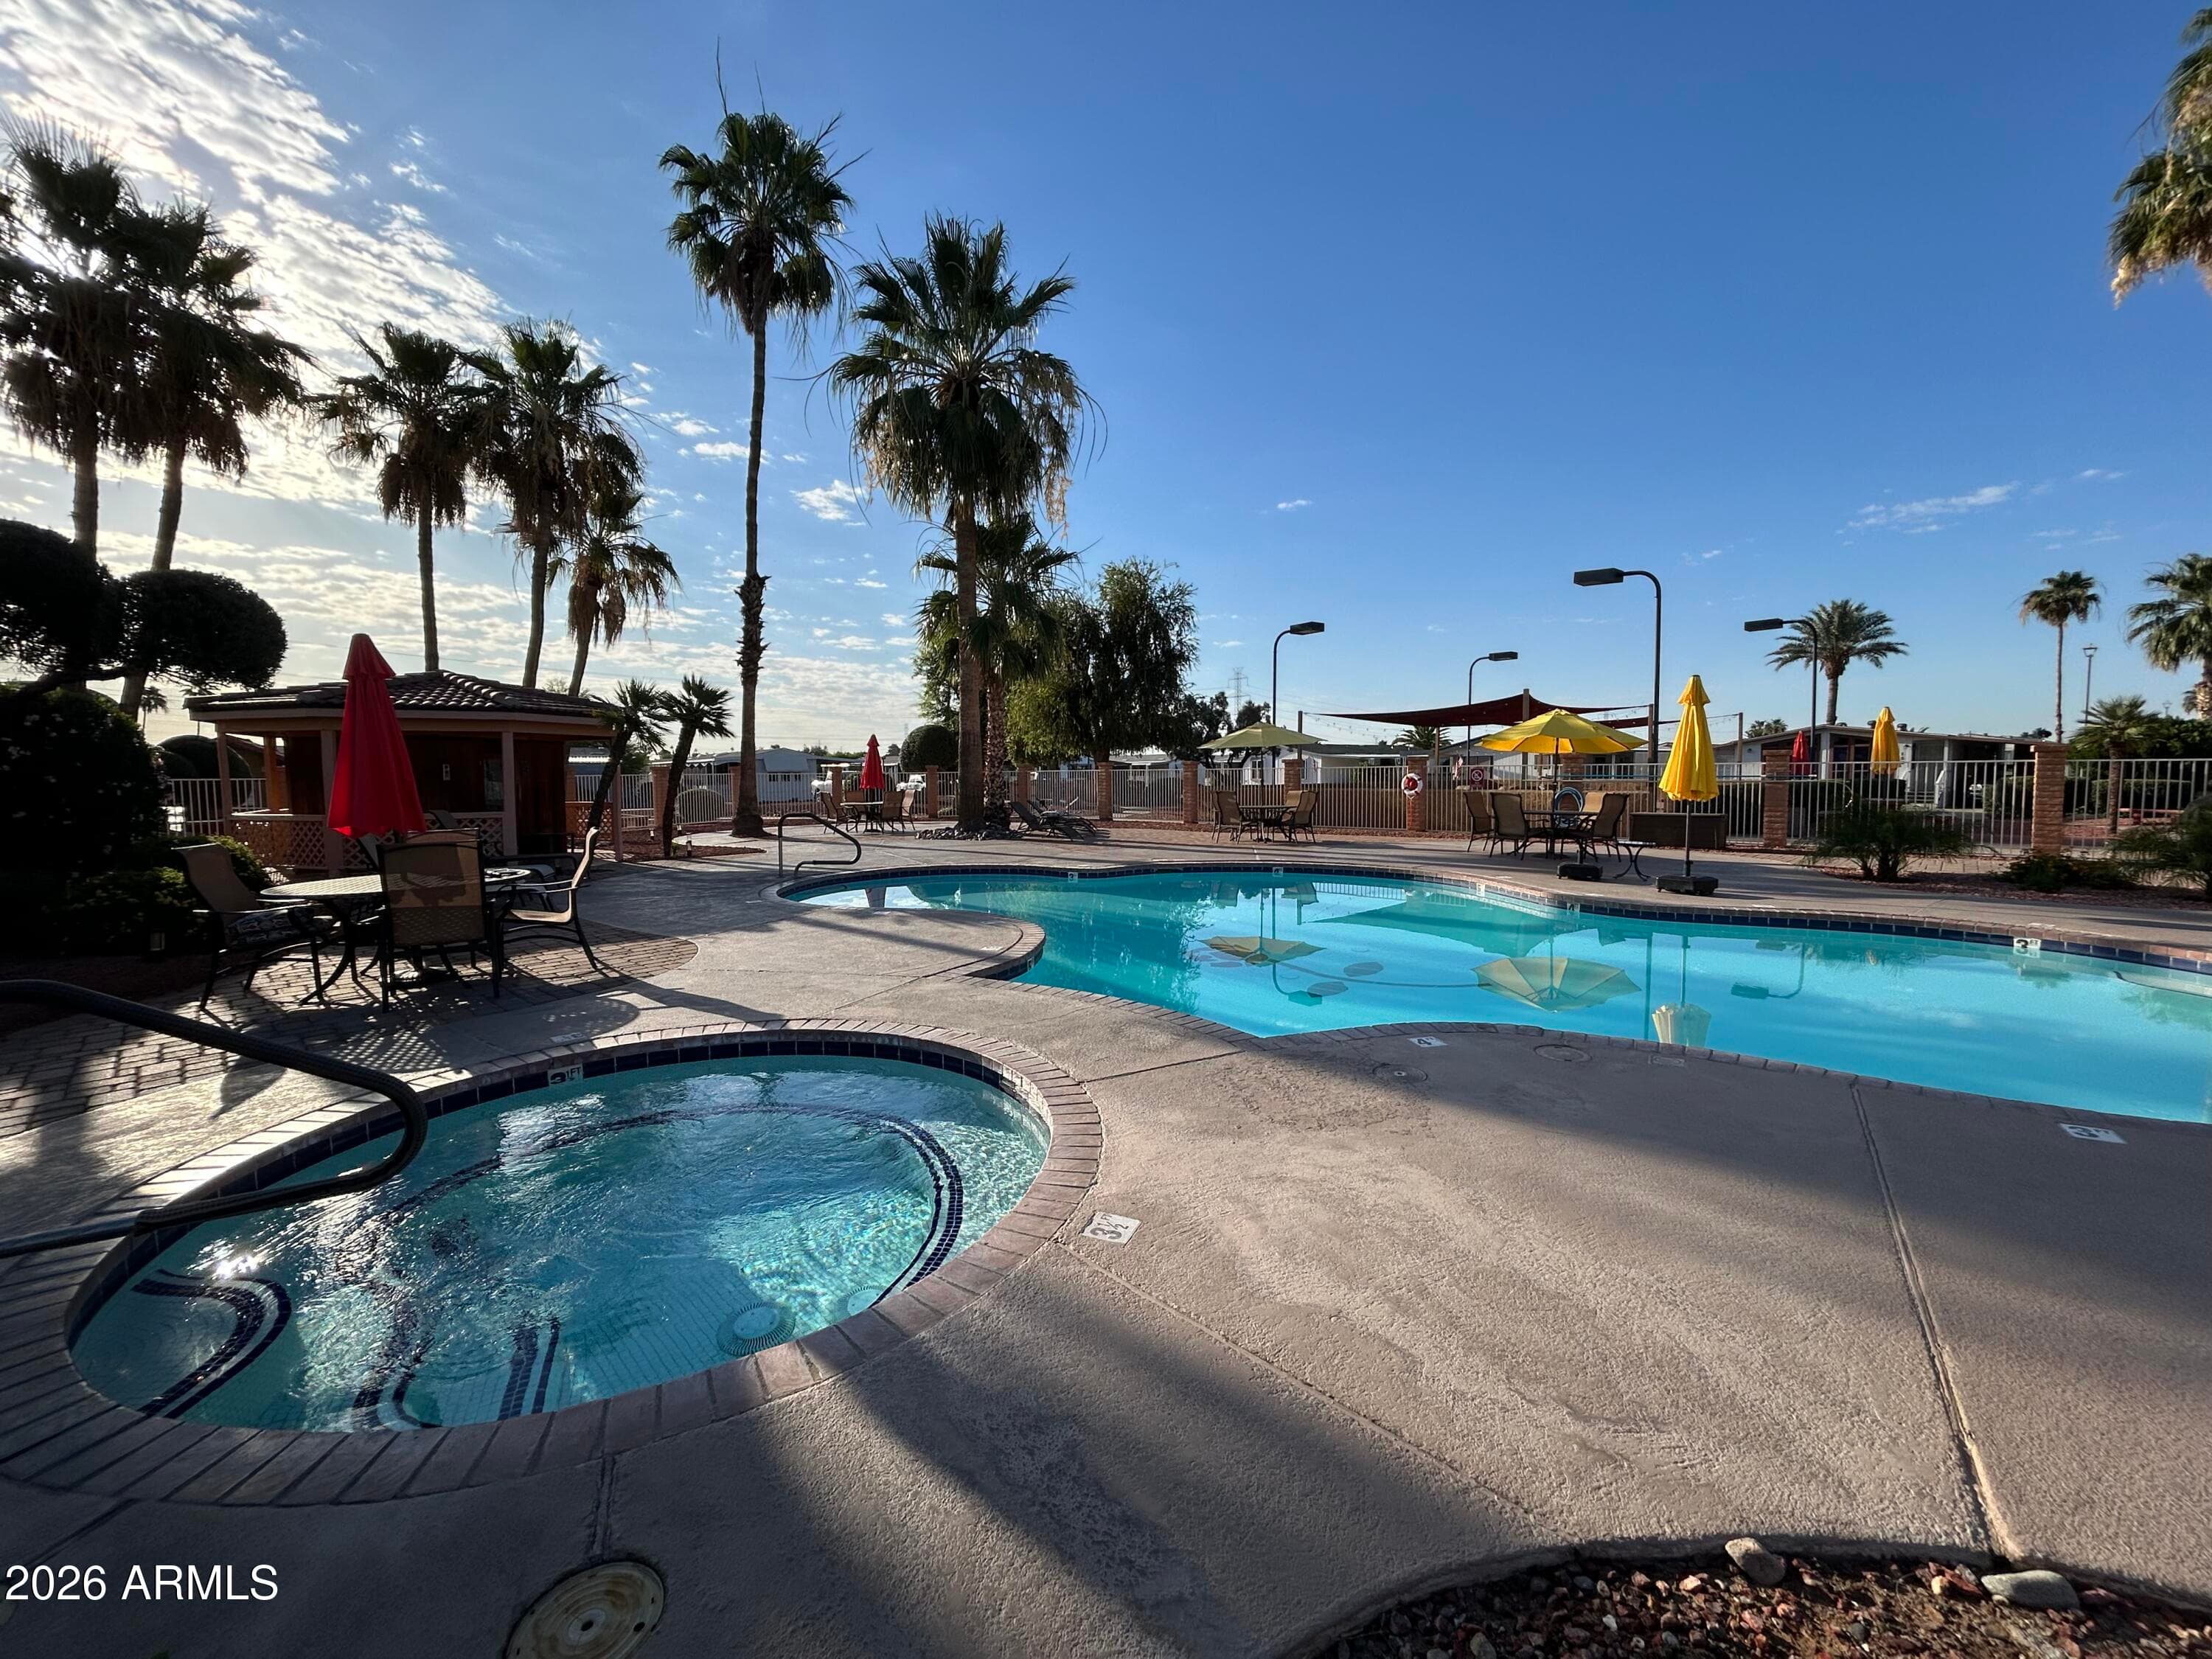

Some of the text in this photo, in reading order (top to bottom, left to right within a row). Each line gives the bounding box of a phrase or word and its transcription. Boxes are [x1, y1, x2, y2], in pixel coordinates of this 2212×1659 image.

[2016, 939, 2028, 953] 3
[571, 1066, 581, 1076] FT
[2068, 1126, 2098, 1138] 3
